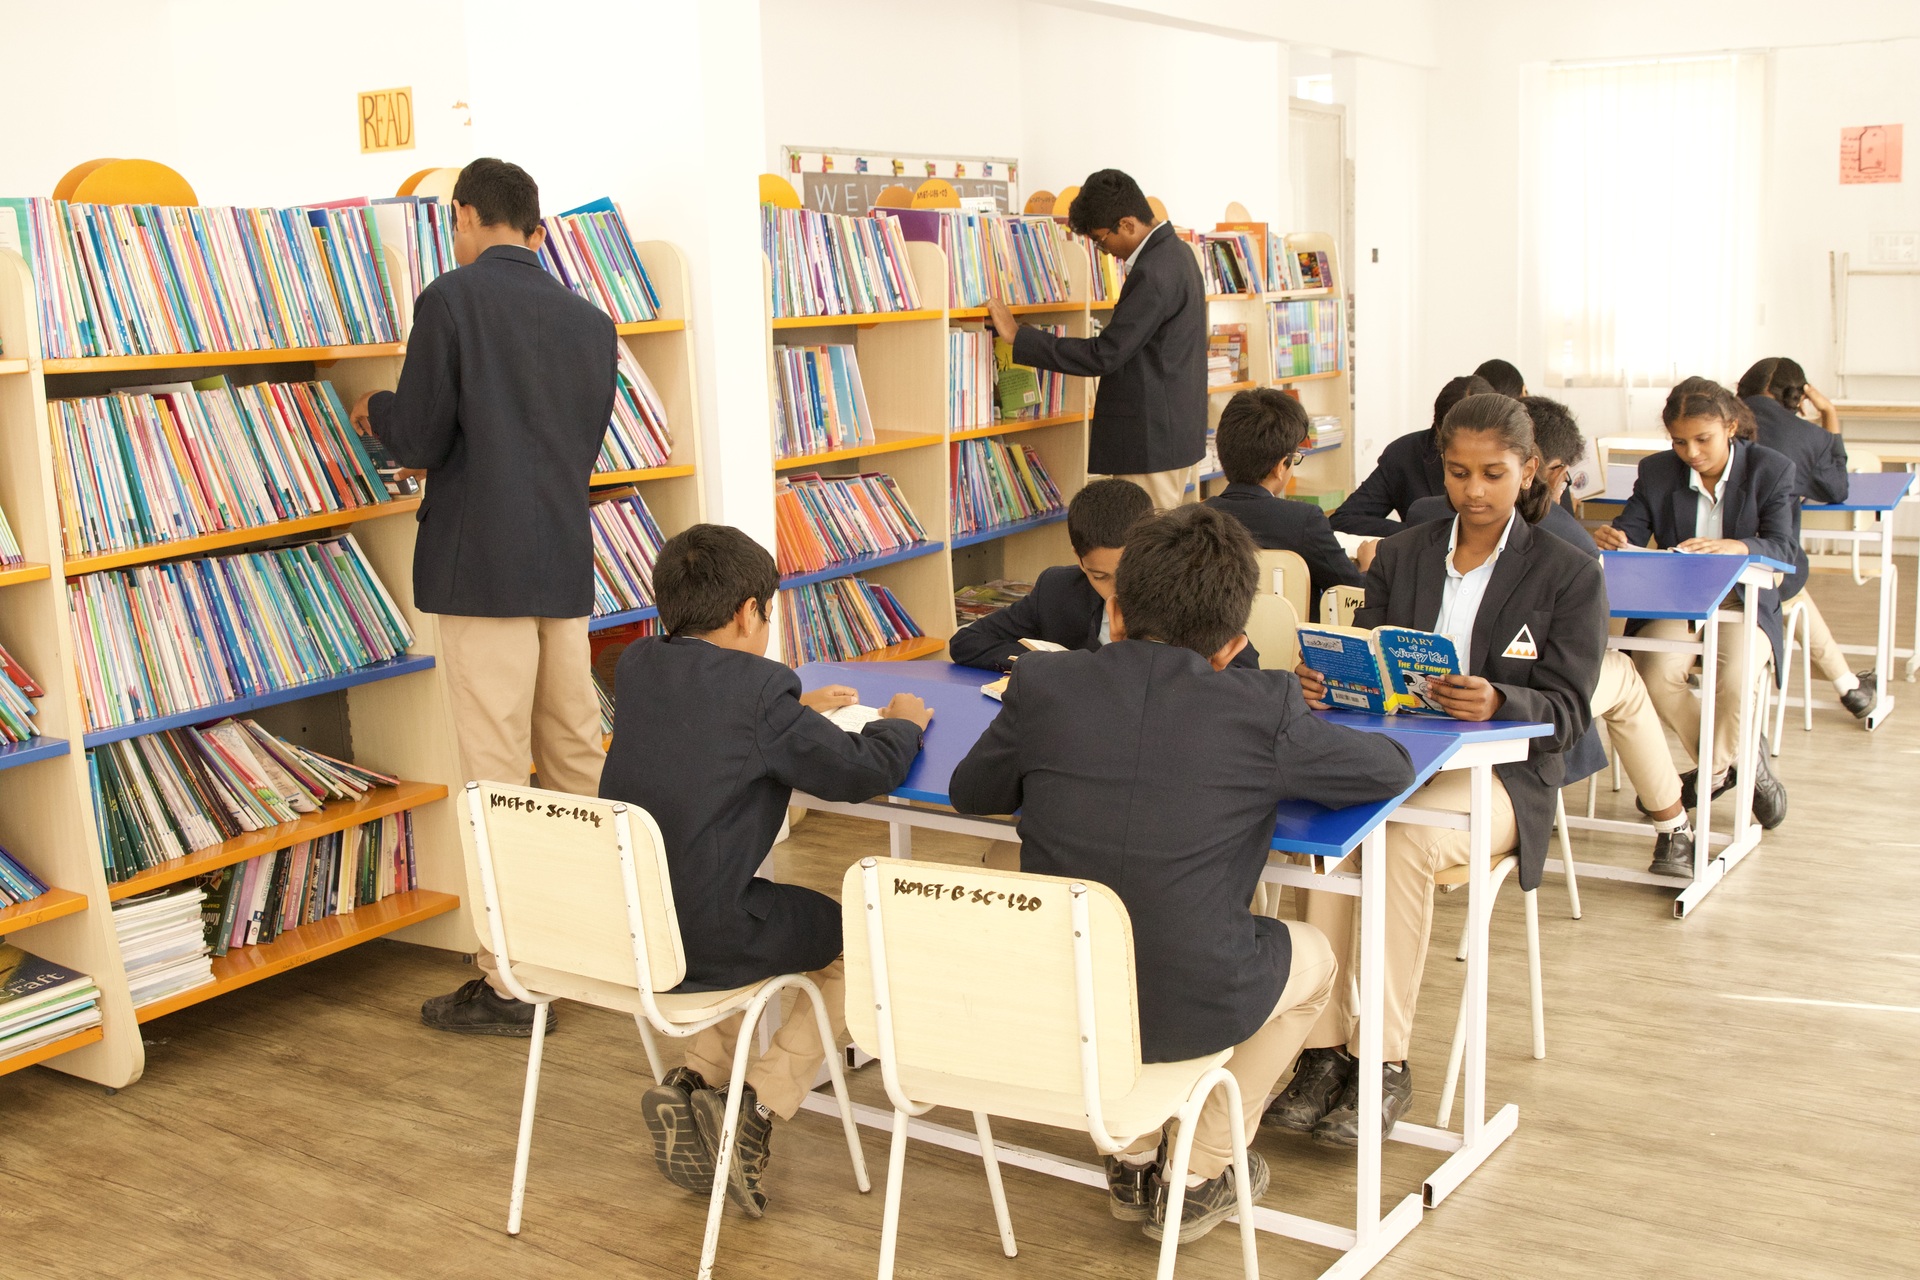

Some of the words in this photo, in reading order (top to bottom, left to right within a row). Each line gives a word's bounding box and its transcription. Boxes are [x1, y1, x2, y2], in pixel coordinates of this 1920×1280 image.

[361, 92, 411, 149] READ
[1396, 635, 1434, 646] DIARY
[1389, 647, 1428, 663] Wimpy
[1428, 652, 1448, 664] Kid
[1398, 660, 1412, 670] THE
[1414, 662, 1452, 674] GETAWAY
